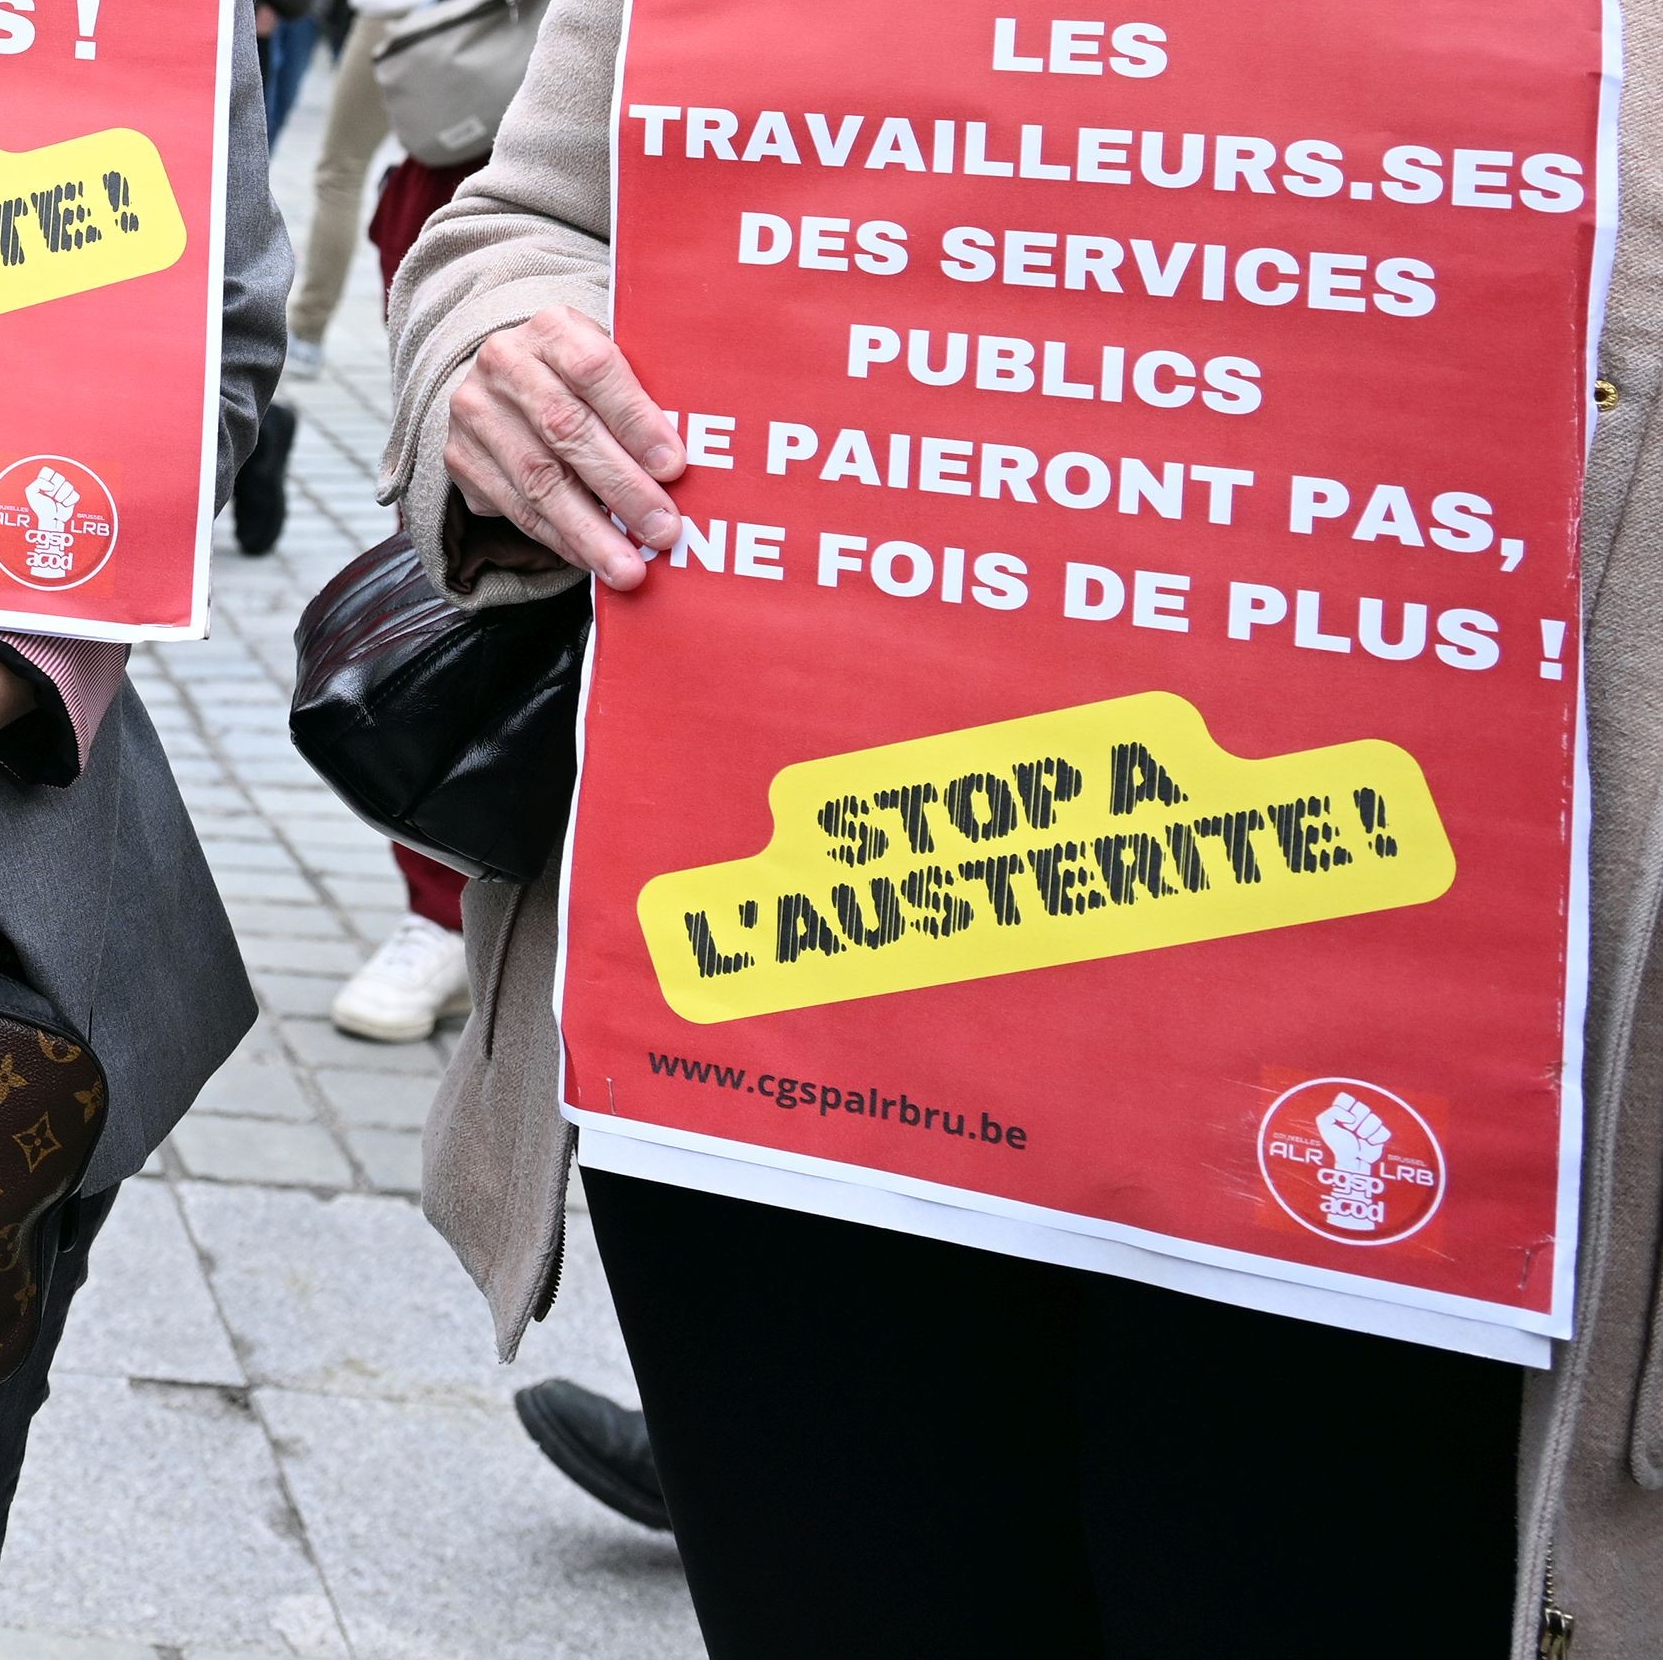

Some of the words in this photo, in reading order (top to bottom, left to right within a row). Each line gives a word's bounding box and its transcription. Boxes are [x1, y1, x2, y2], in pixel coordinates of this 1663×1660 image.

[991, 17, 1168, 79] LES
[628, 103, 1586, 215] TRAVAILLEURS.SES
[737, 210, 909, 276] DES
[940, 224, 1437, 318] SERVICES
[847, 323, 1263, 416] PUBLICS
[70, 520, 110, 537] LRB
[661, 409, 736, 469] E
[766, 421, 1254, 527] PAIERONT
[1288, 477, 1525, 573] PAS,
[25, 529, 74, 550] cgsp
[25, 550, 73, 570] acod
[603, 514, 786, 581] NE
[817, 534, 1029, 610] FOIS
[1064, 562, 1191, 634] DE
[1226, 581, 1501, 671] PLUS
[1539, 619, 1568, 681] !
[817, 756, 1082, 866] STOP
[1108, 742, 1189, 815] A
[684, 795, 1354, 979] L'AUSTERITE
[648, 1051, 1028, 1150] www.cgspalrbru.be
[1269, 1141, 1324, 1165] ALR
[1316, 1168, 1385, 1198] cgsp
[1379, 1162, 1435, 1186] LRB
[1319, 1194, 1385, 1223] acod
